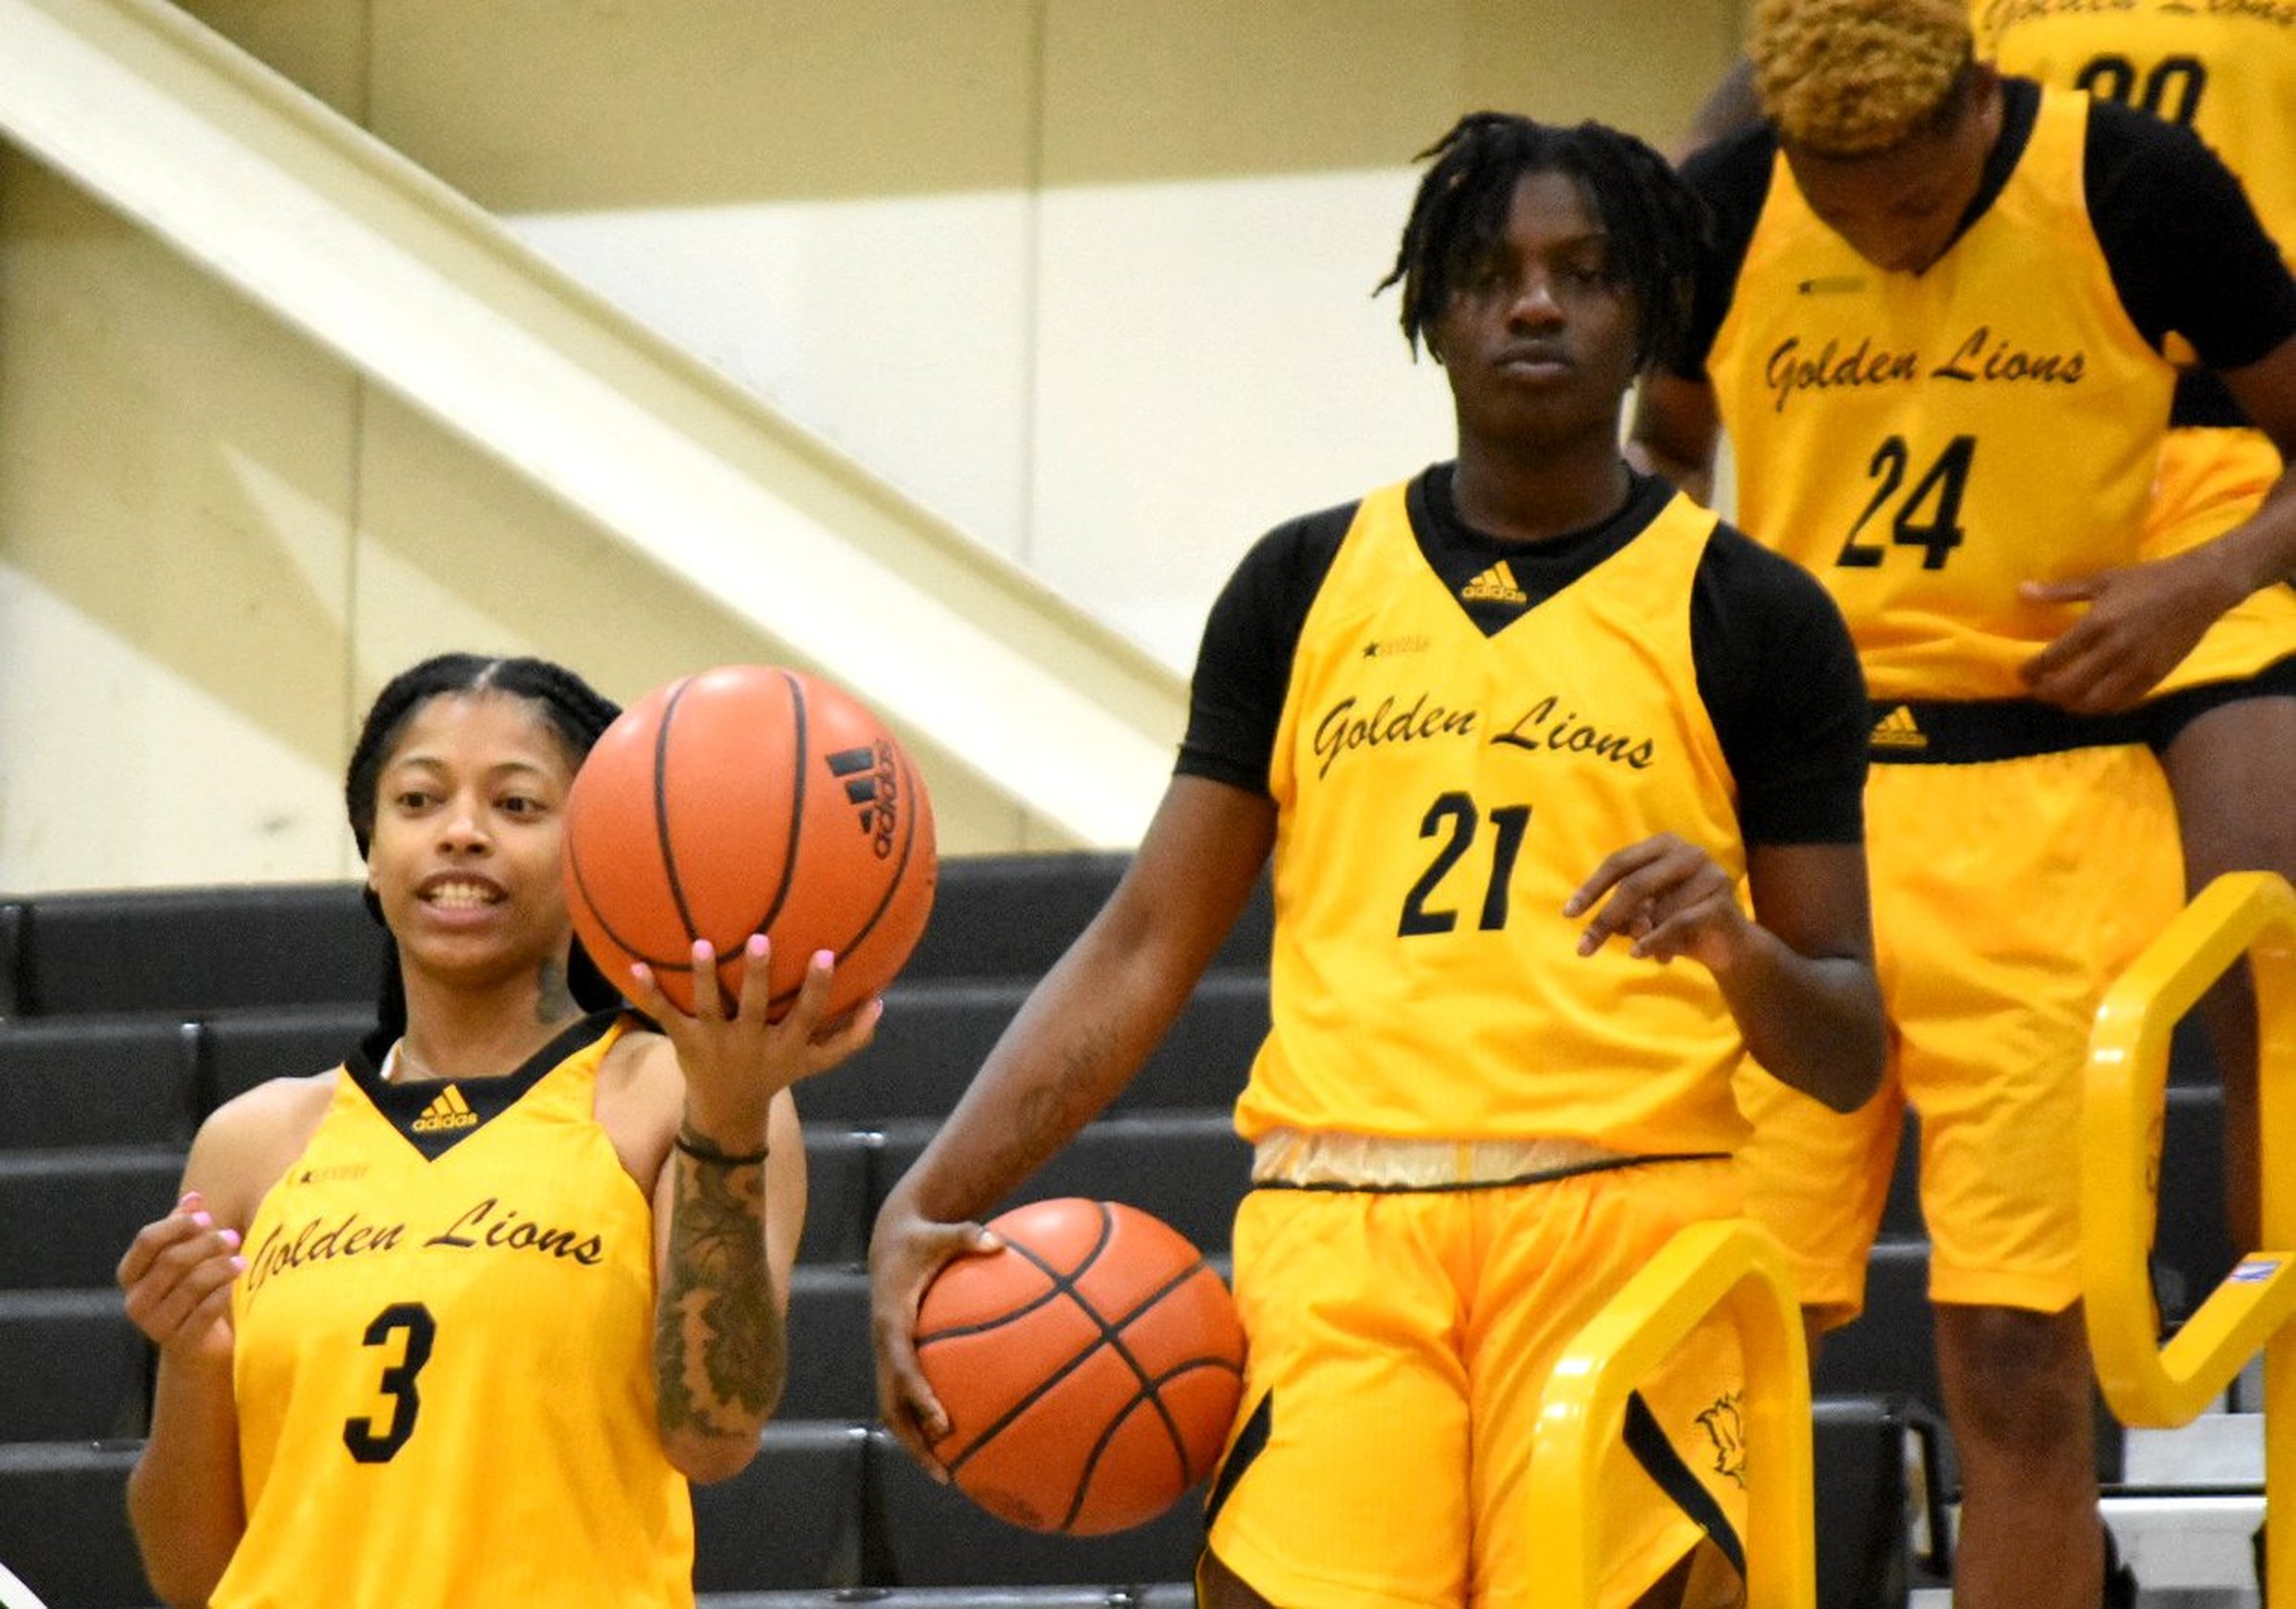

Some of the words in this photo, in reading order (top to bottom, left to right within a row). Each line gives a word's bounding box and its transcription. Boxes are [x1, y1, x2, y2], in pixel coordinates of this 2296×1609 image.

[1766, 337, 1916, 412] Golden
[1931, 326, 2086, 385] Lions
[1835, 434, 1976, 570] 24
[1461, 584, 1528, 605] adidas
[1314, 693, 1478, 781] Golden
[1490, 695, 1654, 769] Lions
[1397, 790, 1533, 937] 21
[411, 1113, 478, 1133] adidas
[246, 1213, 406, 1316] Golden
[422, 1198, 604, 1266] Lions
[342, 1302, 437, 1464] 3
